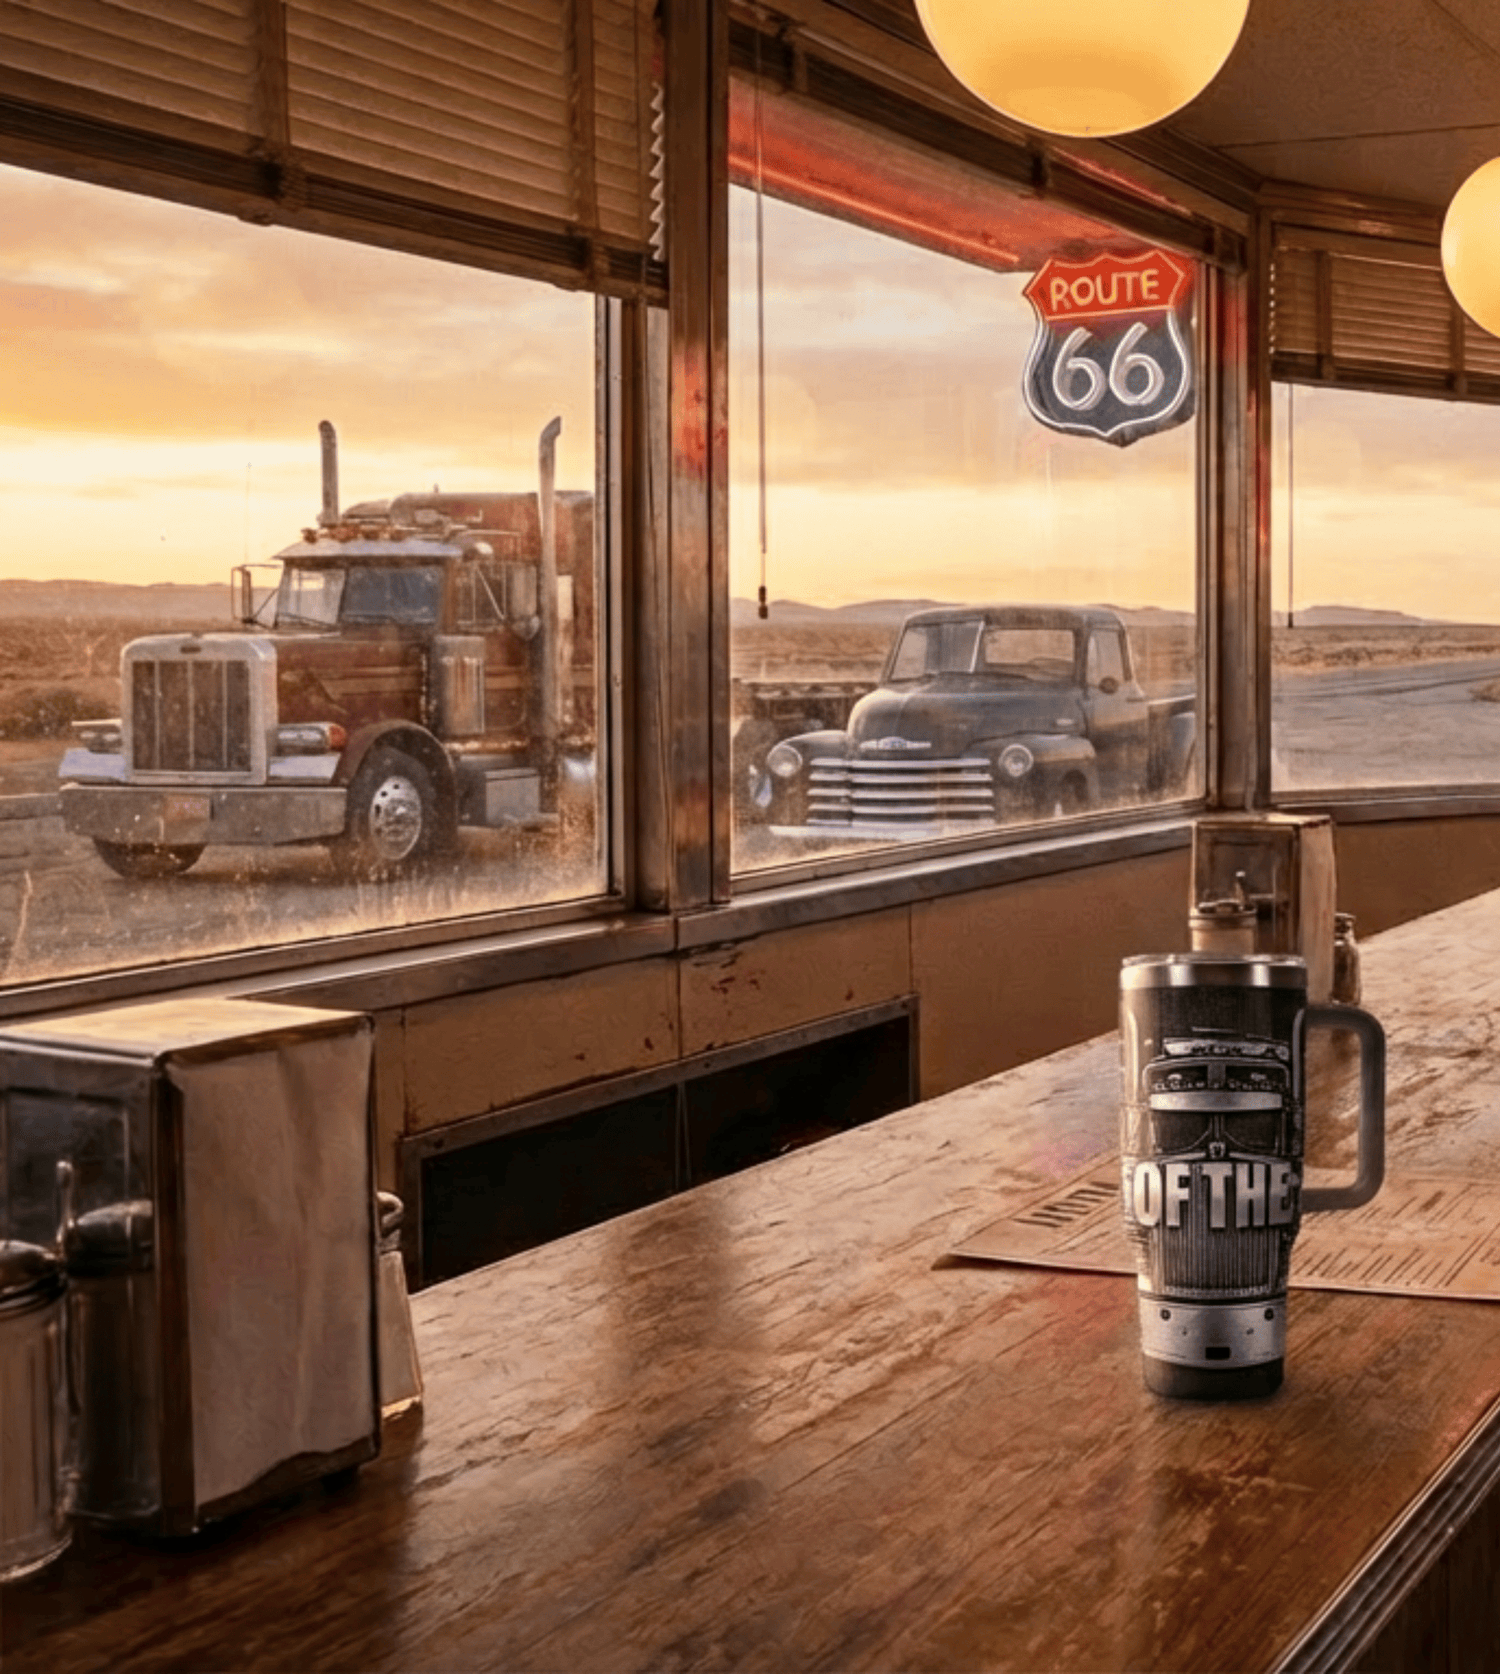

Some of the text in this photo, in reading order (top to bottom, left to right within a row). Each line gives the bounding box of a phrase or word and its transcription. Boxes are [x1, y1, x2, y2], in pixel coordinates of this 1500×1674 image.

[1049, 268, 1160, 313] ROUTE
[1052, 321, 1165, 411] 66
[1133, 1161, 1191, 1227] OF
[1201, 1161, 1296, 1229] THE
